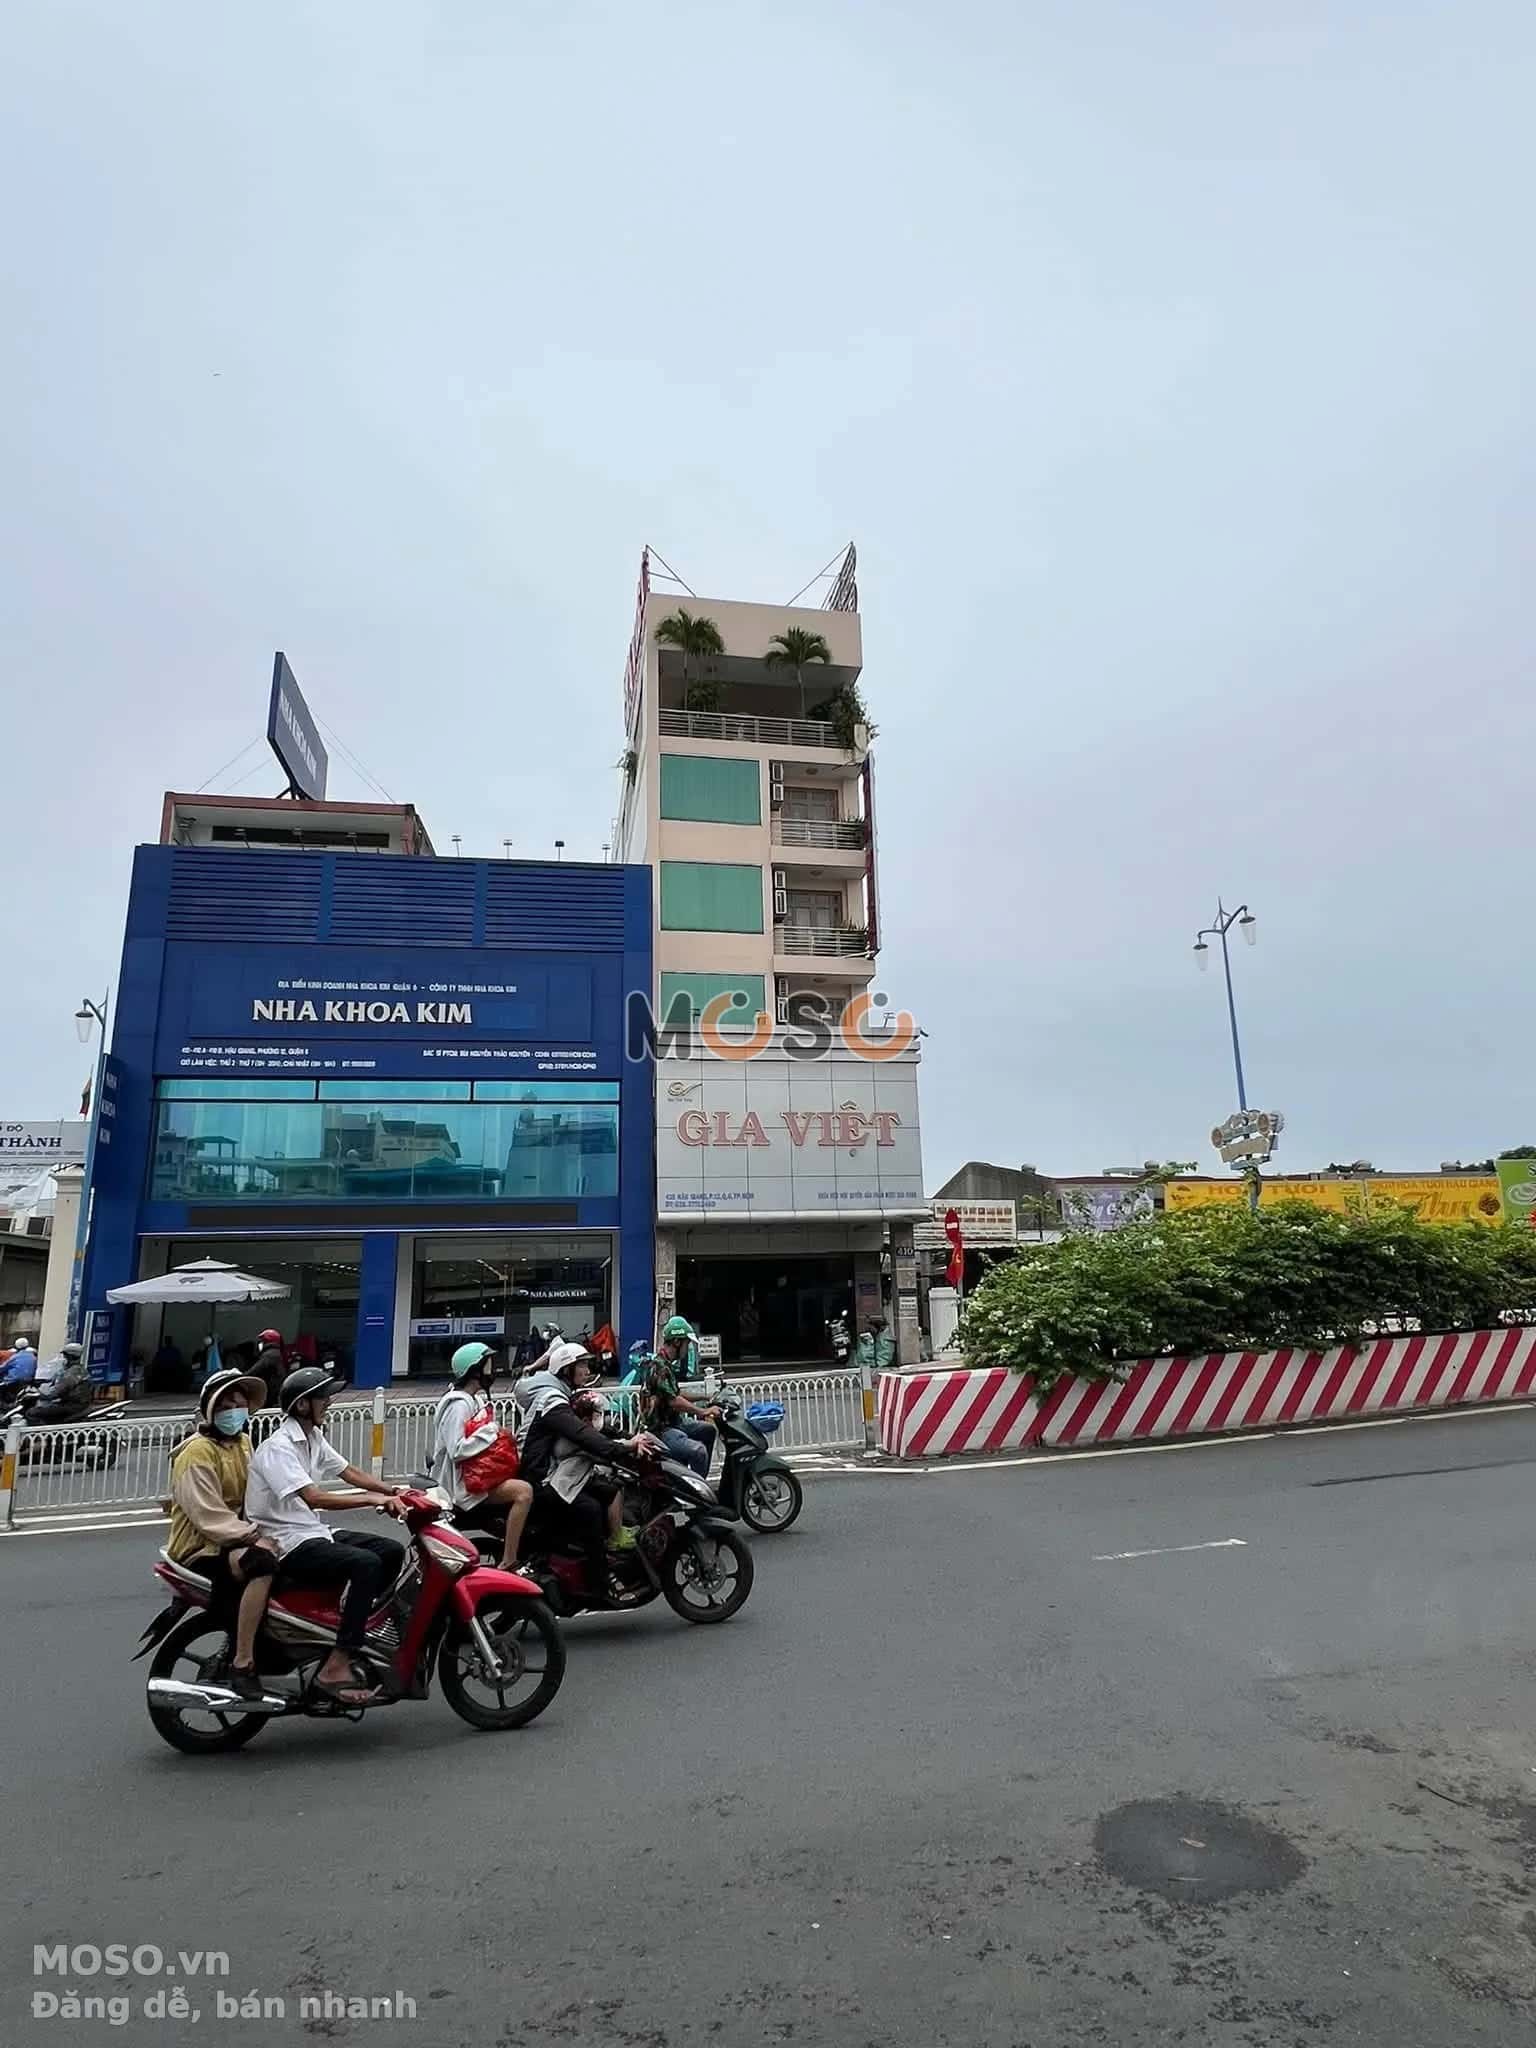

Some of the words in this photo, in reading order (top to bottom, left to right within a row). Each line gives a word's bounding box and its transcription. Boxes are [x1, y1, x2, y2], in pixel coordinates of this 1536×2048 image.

[253, 1000, 318, 1021] NHA
[324, 1000, 411, 1022] KHOA
[417, 1003, 472, 1024] KIM
[676, 1109, 770, 1147] GIA
[781, 1100, 902, 1157] VIỆT
